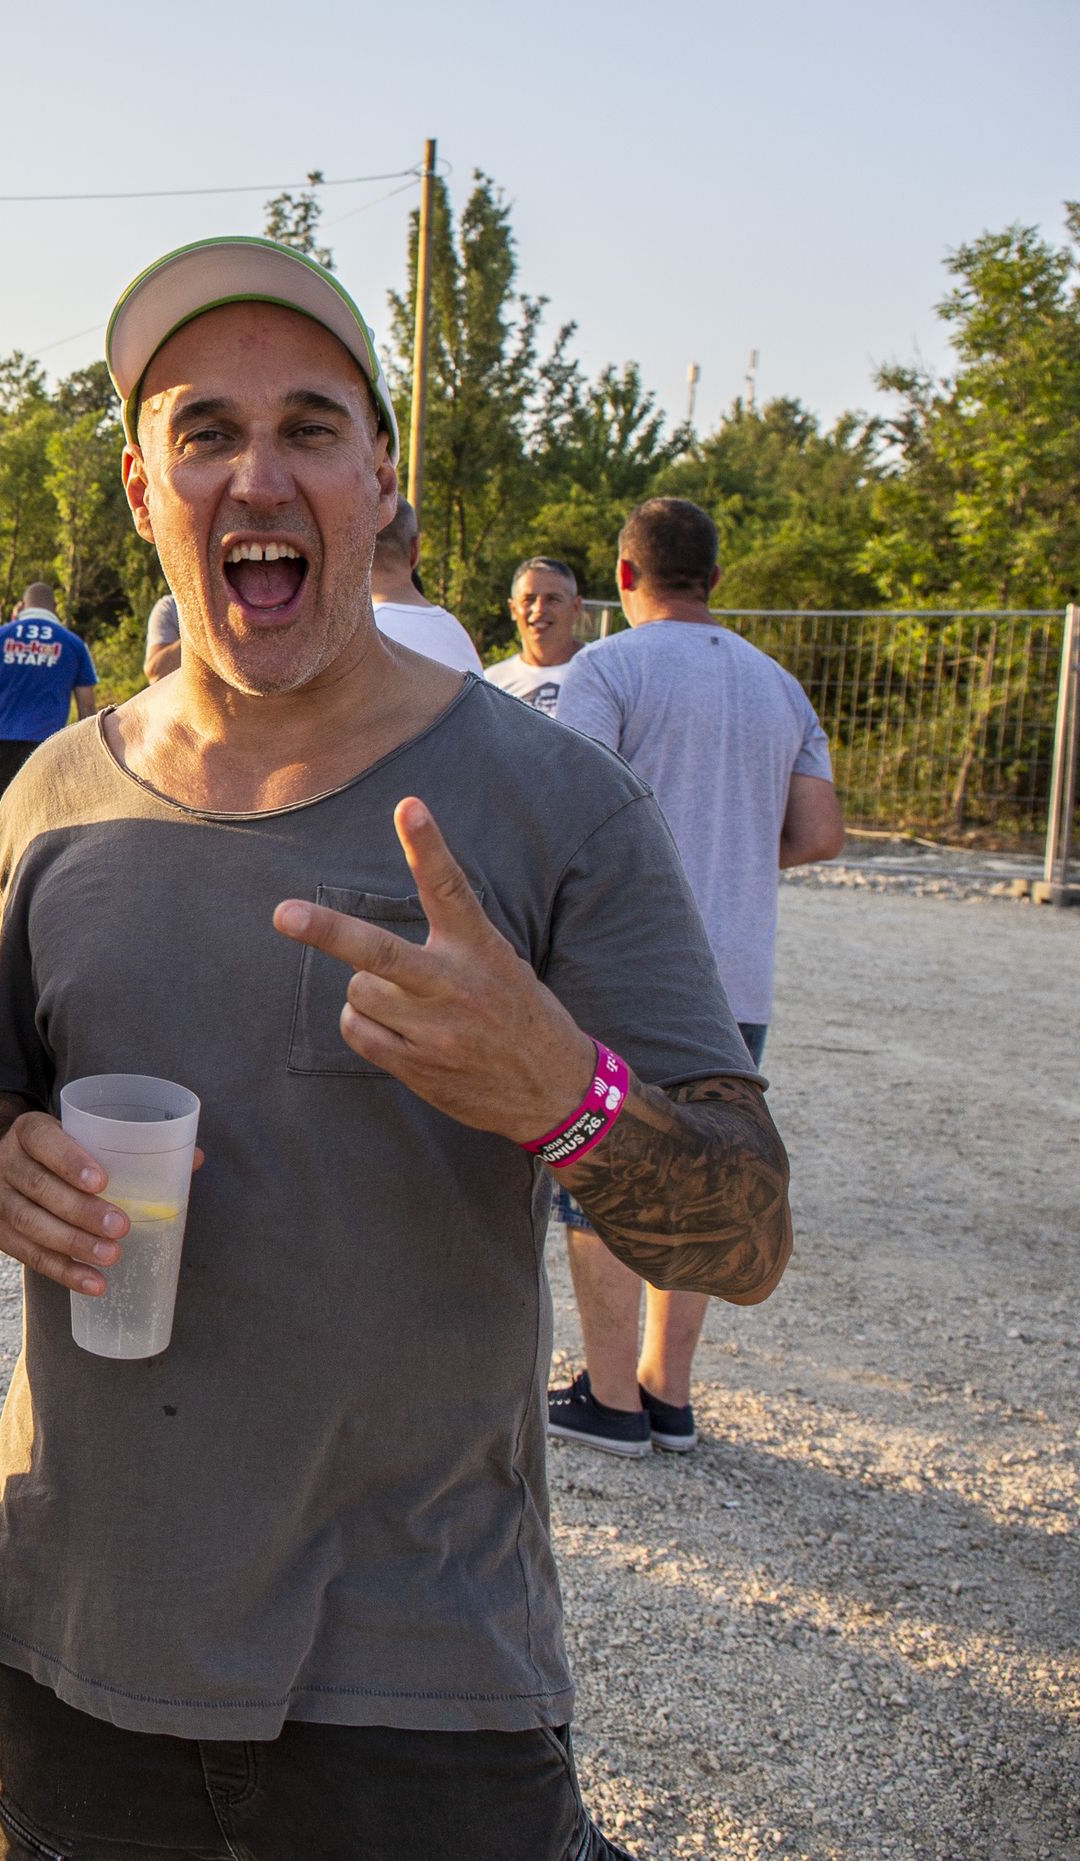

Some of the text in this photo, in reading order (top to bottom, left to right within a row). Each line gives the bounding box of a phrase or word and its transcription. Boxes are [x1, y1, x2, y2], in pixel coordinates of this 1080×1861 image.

[16, 625, 53, 639] 133
[4, 653, 57, 667] STAFF
[583, 1116, 605, 1136] 26.
